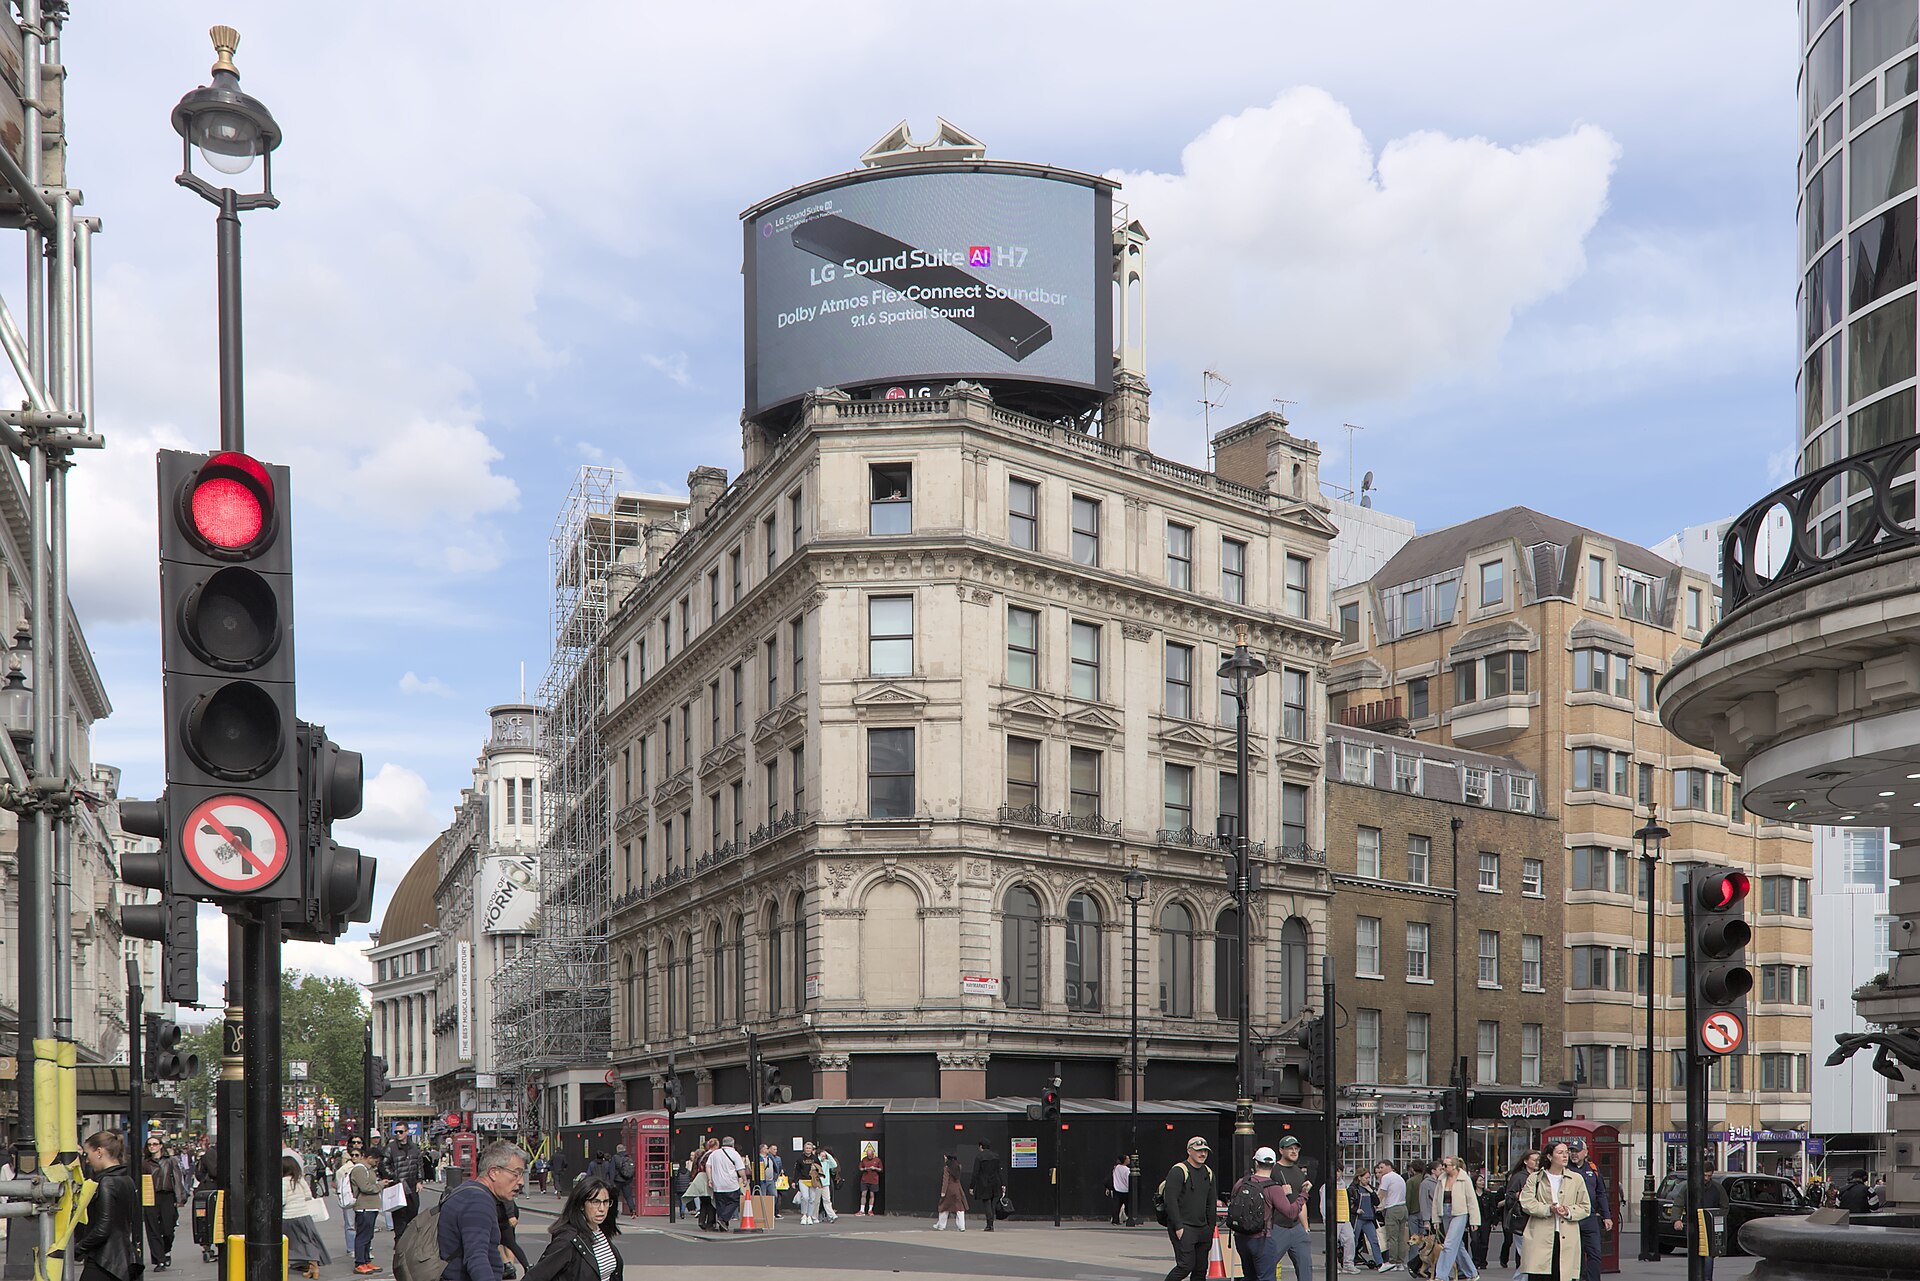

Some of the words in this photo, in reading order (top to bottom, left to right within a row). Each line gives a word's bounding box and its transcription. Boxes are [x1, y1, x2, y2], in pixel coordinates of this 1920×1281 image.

[810, 263, 835, 286] LG
[970, 247, 990, 266] AI
[997, 246, 1029, 268] H7
[777, 306, 817, 328] Dolby
[819, 295, 869, 315] Atmos
[985, 283, 1068, 306] Soundbar
[878, 307, 927, 325] Spatial
[930, 305, 975, 319] Sound
[487, 888, 500, 912] BOOK
[497, 876, 506, 889] OF
[1501, 1098, 1526, 1118] Street
